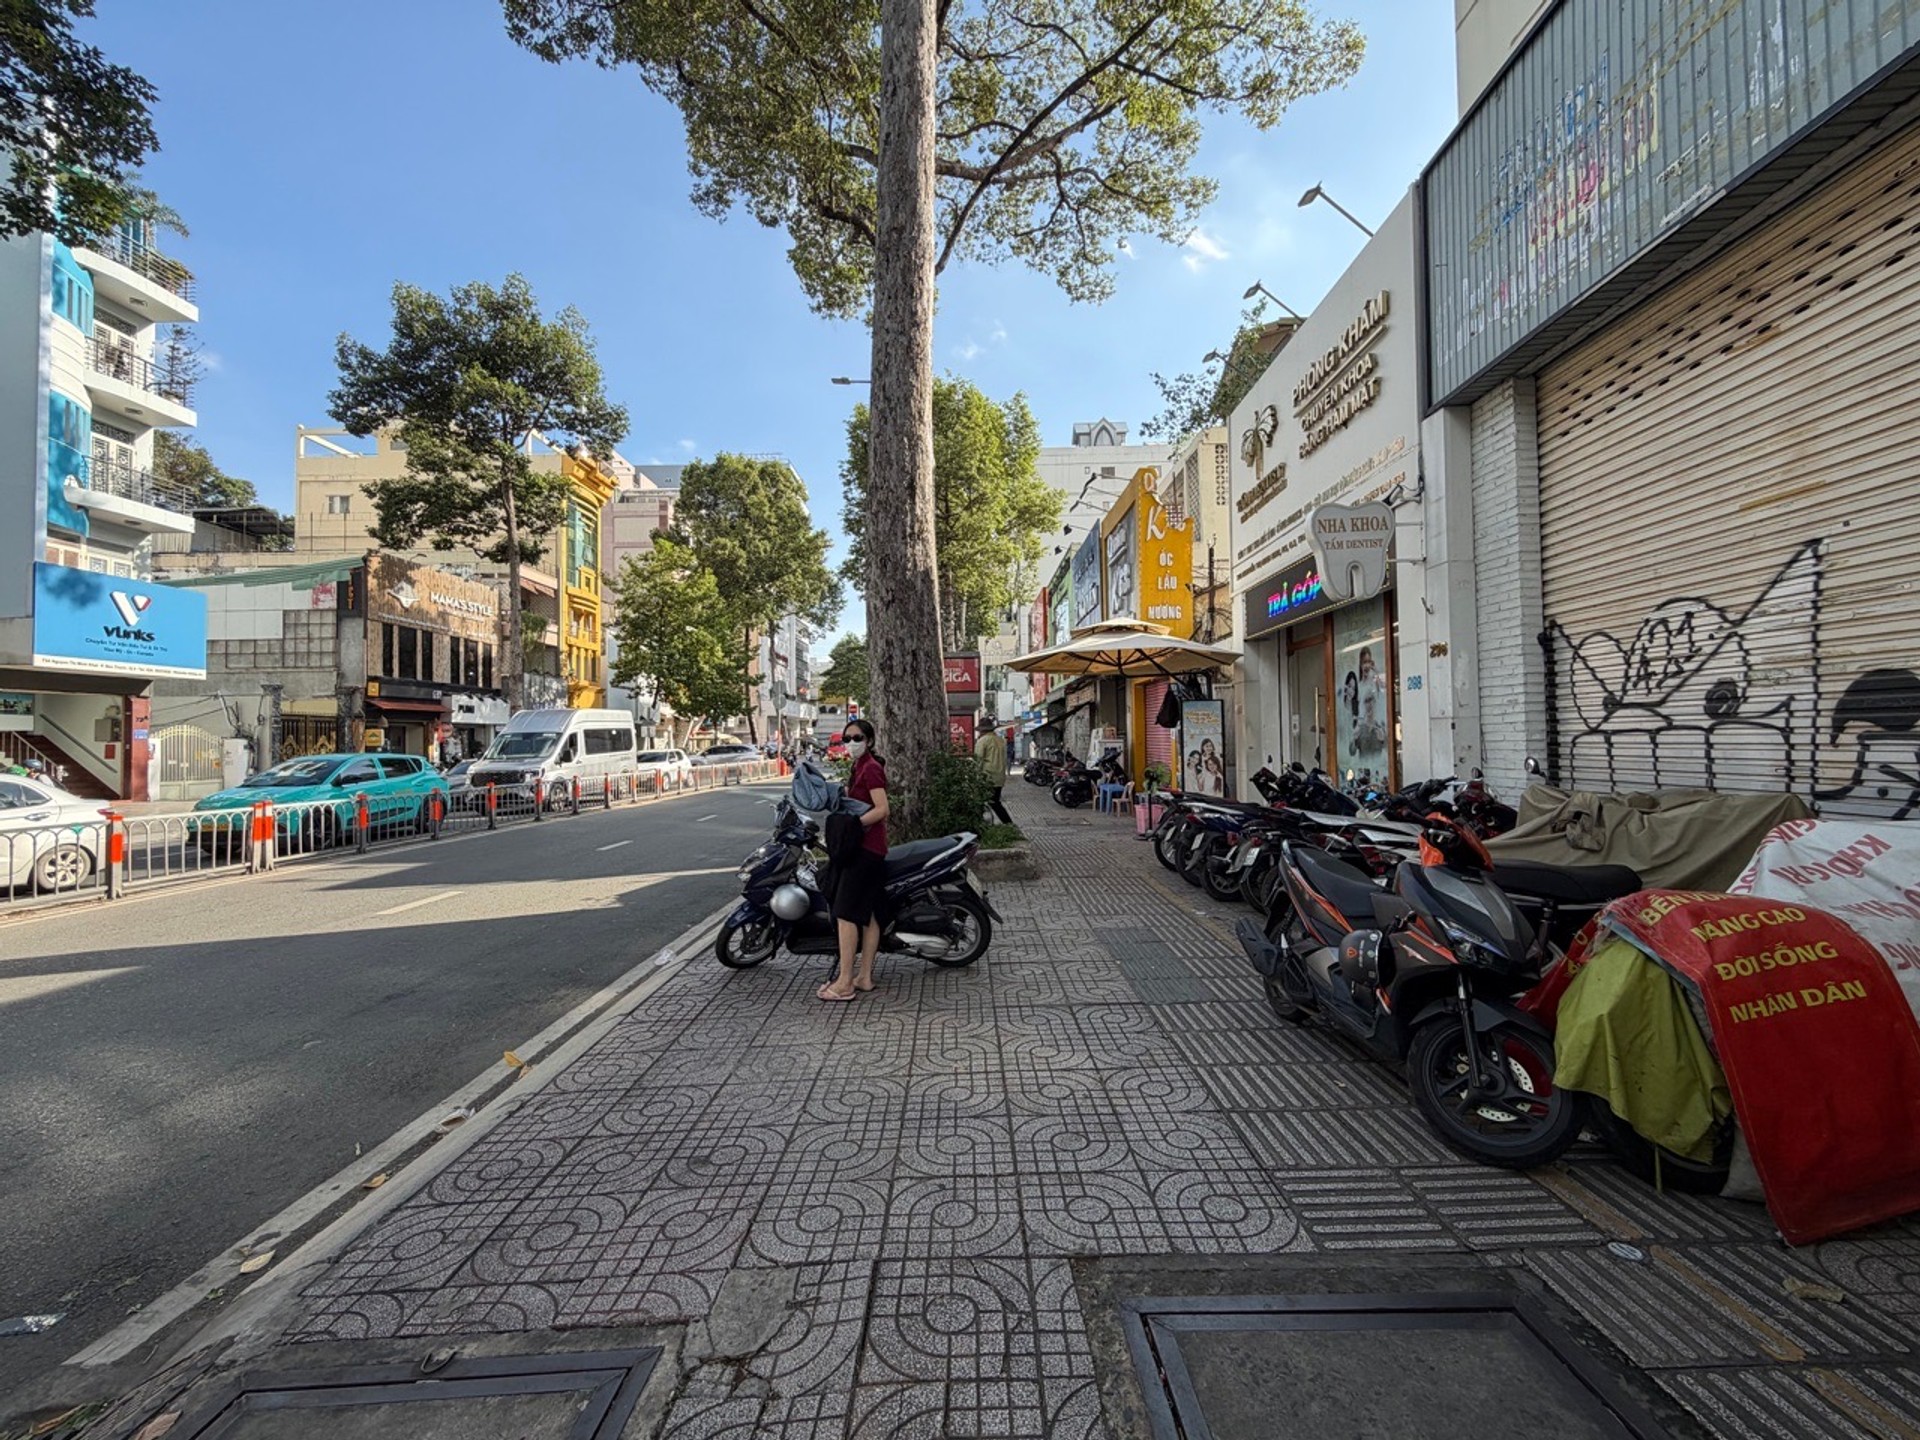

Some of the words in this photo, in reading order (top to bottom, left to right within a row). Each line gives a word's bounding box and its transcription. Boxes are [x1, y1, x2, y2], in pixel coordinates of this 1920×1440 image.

[1292, 346, 1340, 407] PHÒNG
[1339, 290, 1389, 358] KHÁM
[1301, 385, 1340, 431] CHUYÊN
[1340, 353, 1378, 395] KHOA
[1317, 518, 1347, 533] NHA
[1350, 516, 1388, 532] KHOA
[1346, 539, 1384, 549] DENTIST
[467, 602, 494, 616] STYLE
[1267, 580, 1289, 618] TRẢ
[1757, 907, 1806, 926] CAO
[1760, 940, 1839, 971] SỐNG
[1728, 989, 1798, 1024] NHÂN
[1798, 979, 1867, 1008] DÂN
